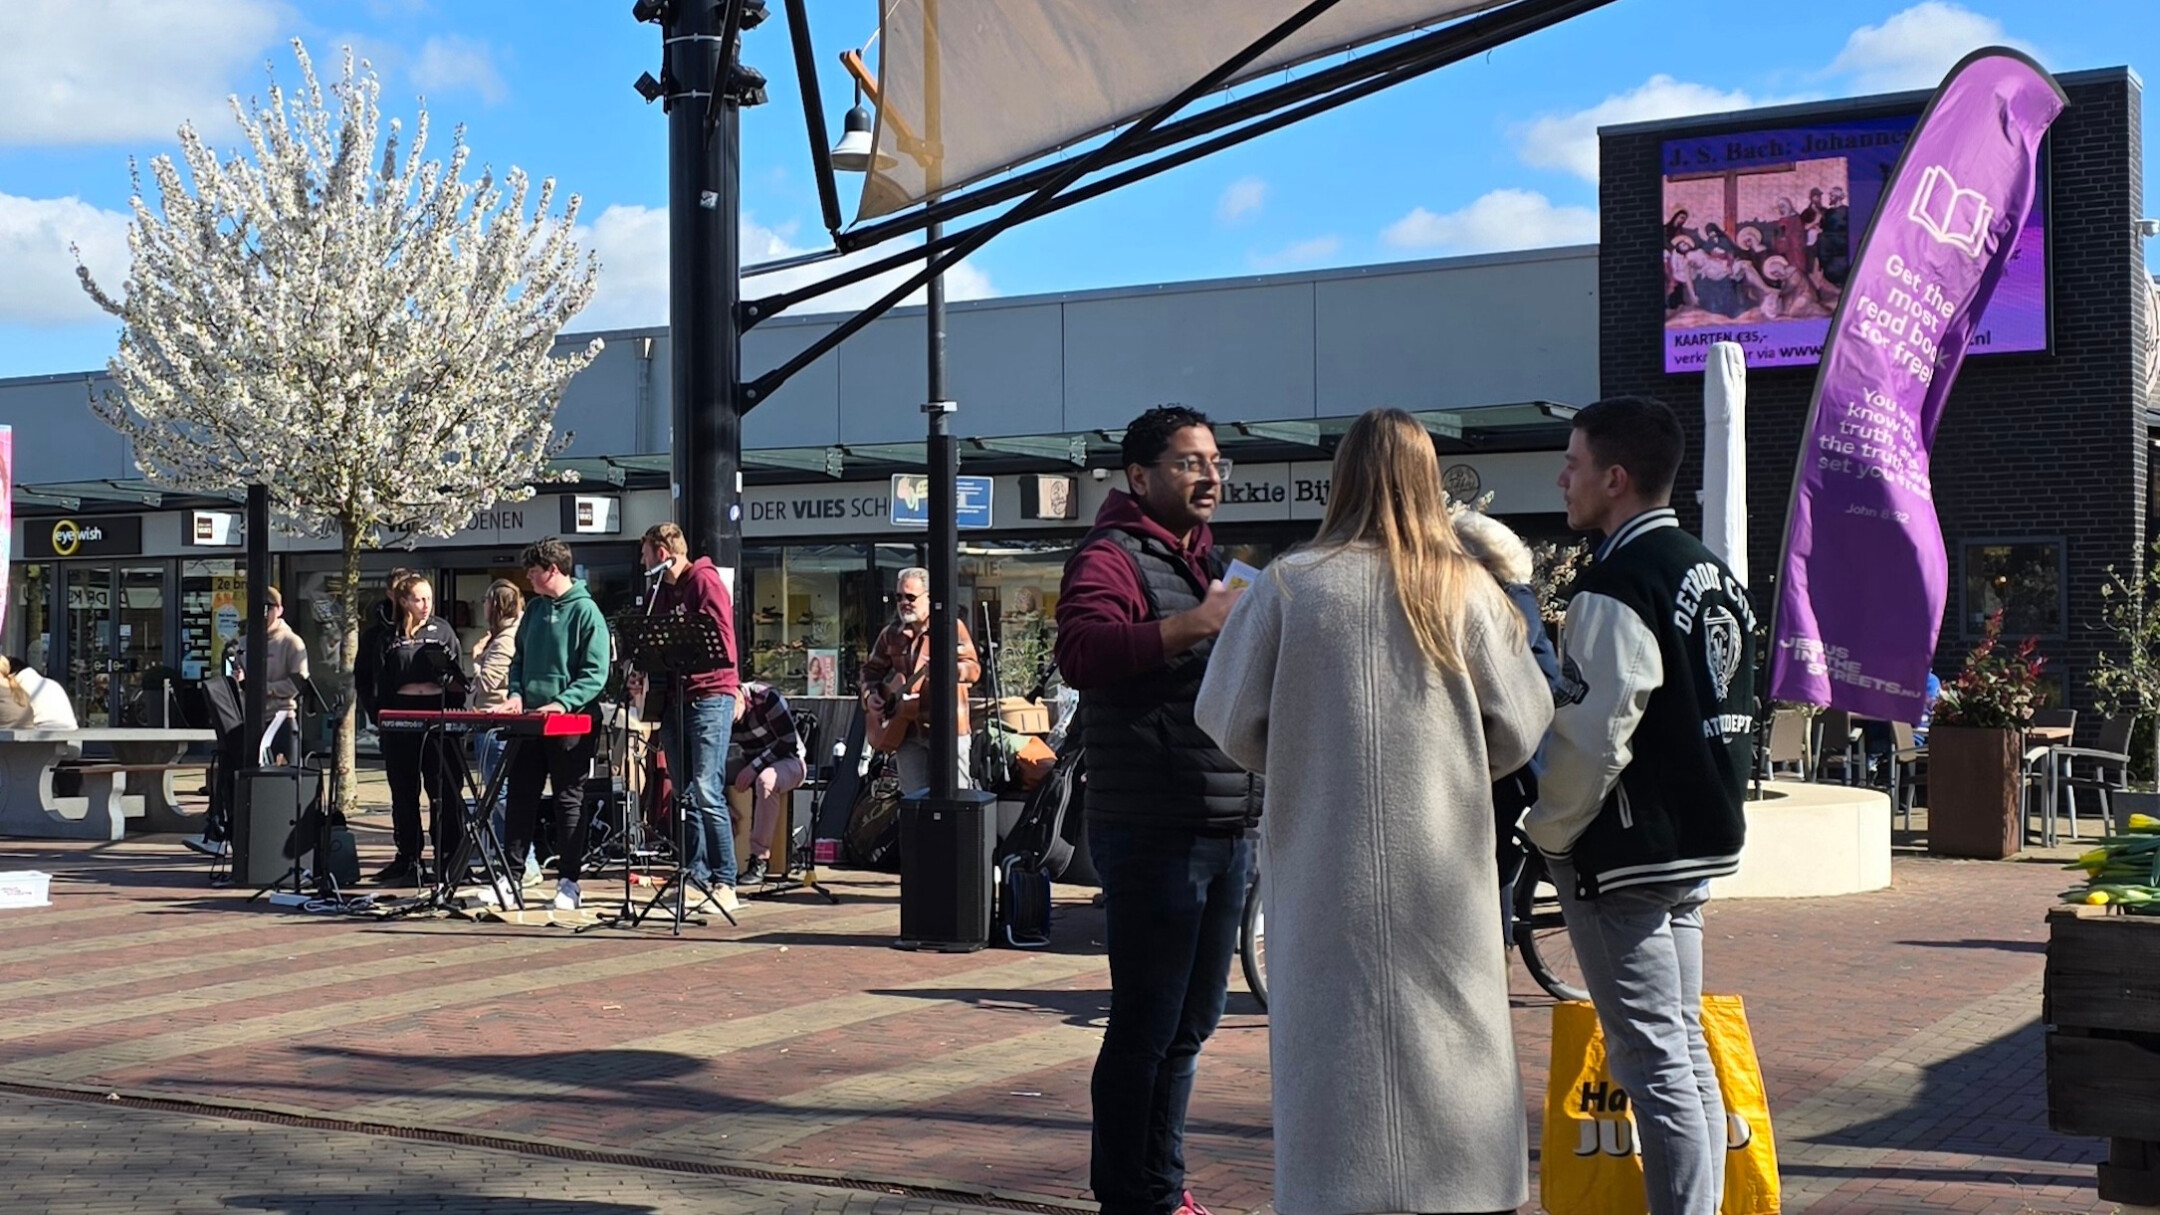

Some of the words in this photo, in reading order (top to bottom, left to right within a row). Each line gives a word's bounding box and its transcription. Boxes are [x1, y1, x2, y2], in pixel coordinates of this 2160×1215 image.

[1669, 149, 1688, 167] J.
[1697, 147, 1717, 164] S.
[1726, 139, 1792, 161] Bach:
[1886, 254, 1921, 293] Get
[1926, 282, 1956, 319] the
[1888, 287, 1940, 334] most
[1674, 332, 1733, 348] KAARTEN
[1857, 296, 1908, 336] read
[1909, 329, 1951, 370] book
[1757, 346, 1776, 359] via
[1859, 320, 1891, 349] for
[1894, 342, 1935, 389] free!
[1863, 387, 1897, 412] You
[1847, 401, 1900, 432] know
[1839, 420, 1897, 452] truth,
[1818, 434, 1855, 455] the
[1861, 442, 1905, 475] truth
[1817, 456, 1853, 474] set
[1857, 462, 1895, 482] you
[751, 501, 787, 522] DER
[792, 496, 846, 519] VLIES
[851, 495, 891, 517] SCH
[1845, 503, 1878, 518] John
[217, 577, 230, 590] 2e
[1673, 561, 1723, 635] DETROIT
[1780, 636, 1850, 660] JESUS
[1794, 649, 1819, 663] IN
[1825, 655, 1862, 674] THE
[1580, 1081, 1626, 1113] Ha
